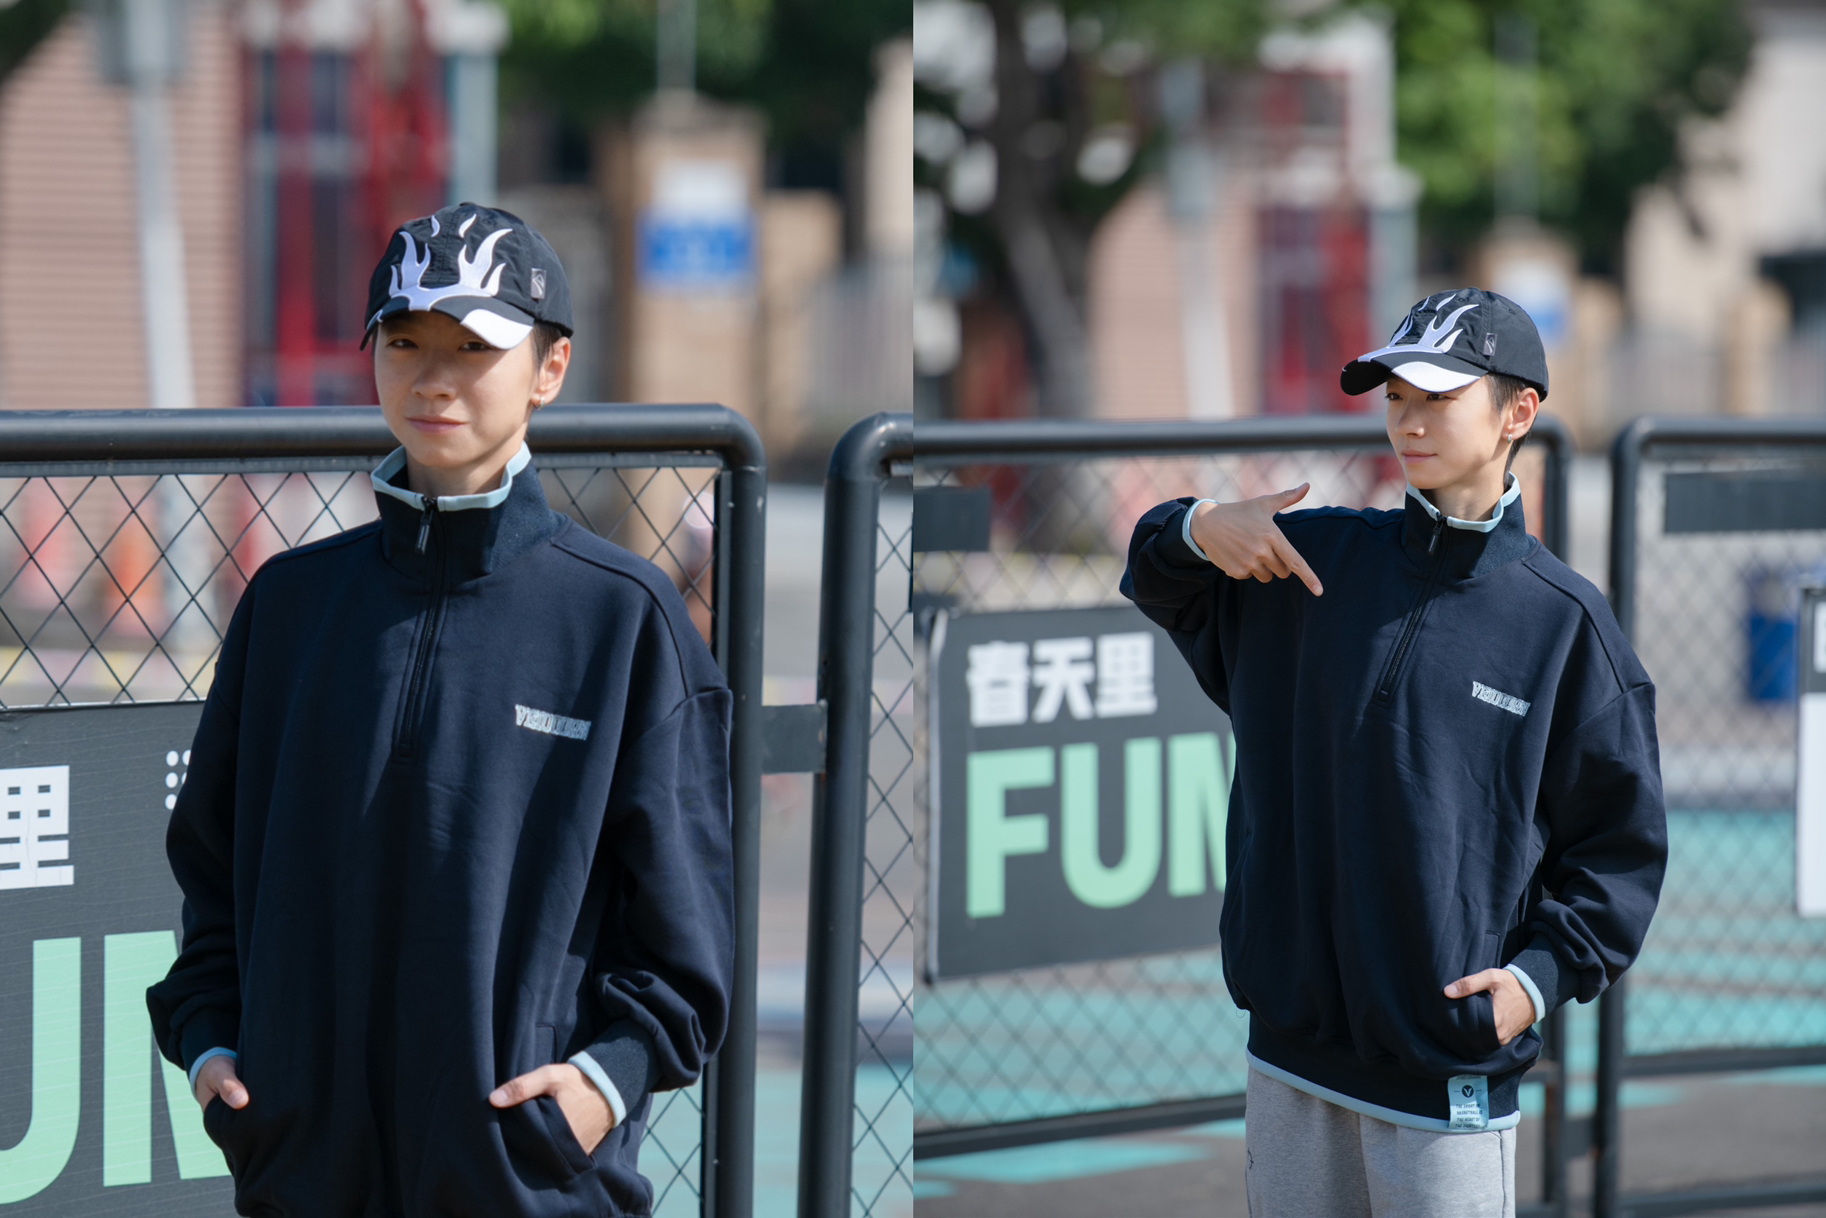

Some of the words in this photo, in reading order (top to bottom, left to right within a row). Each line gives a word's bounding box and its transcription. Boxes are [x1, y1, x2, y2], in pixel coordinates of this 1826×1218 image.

[966, 631, 1158, 728] 春天里
[966, 731, 1236, 919] FUN
